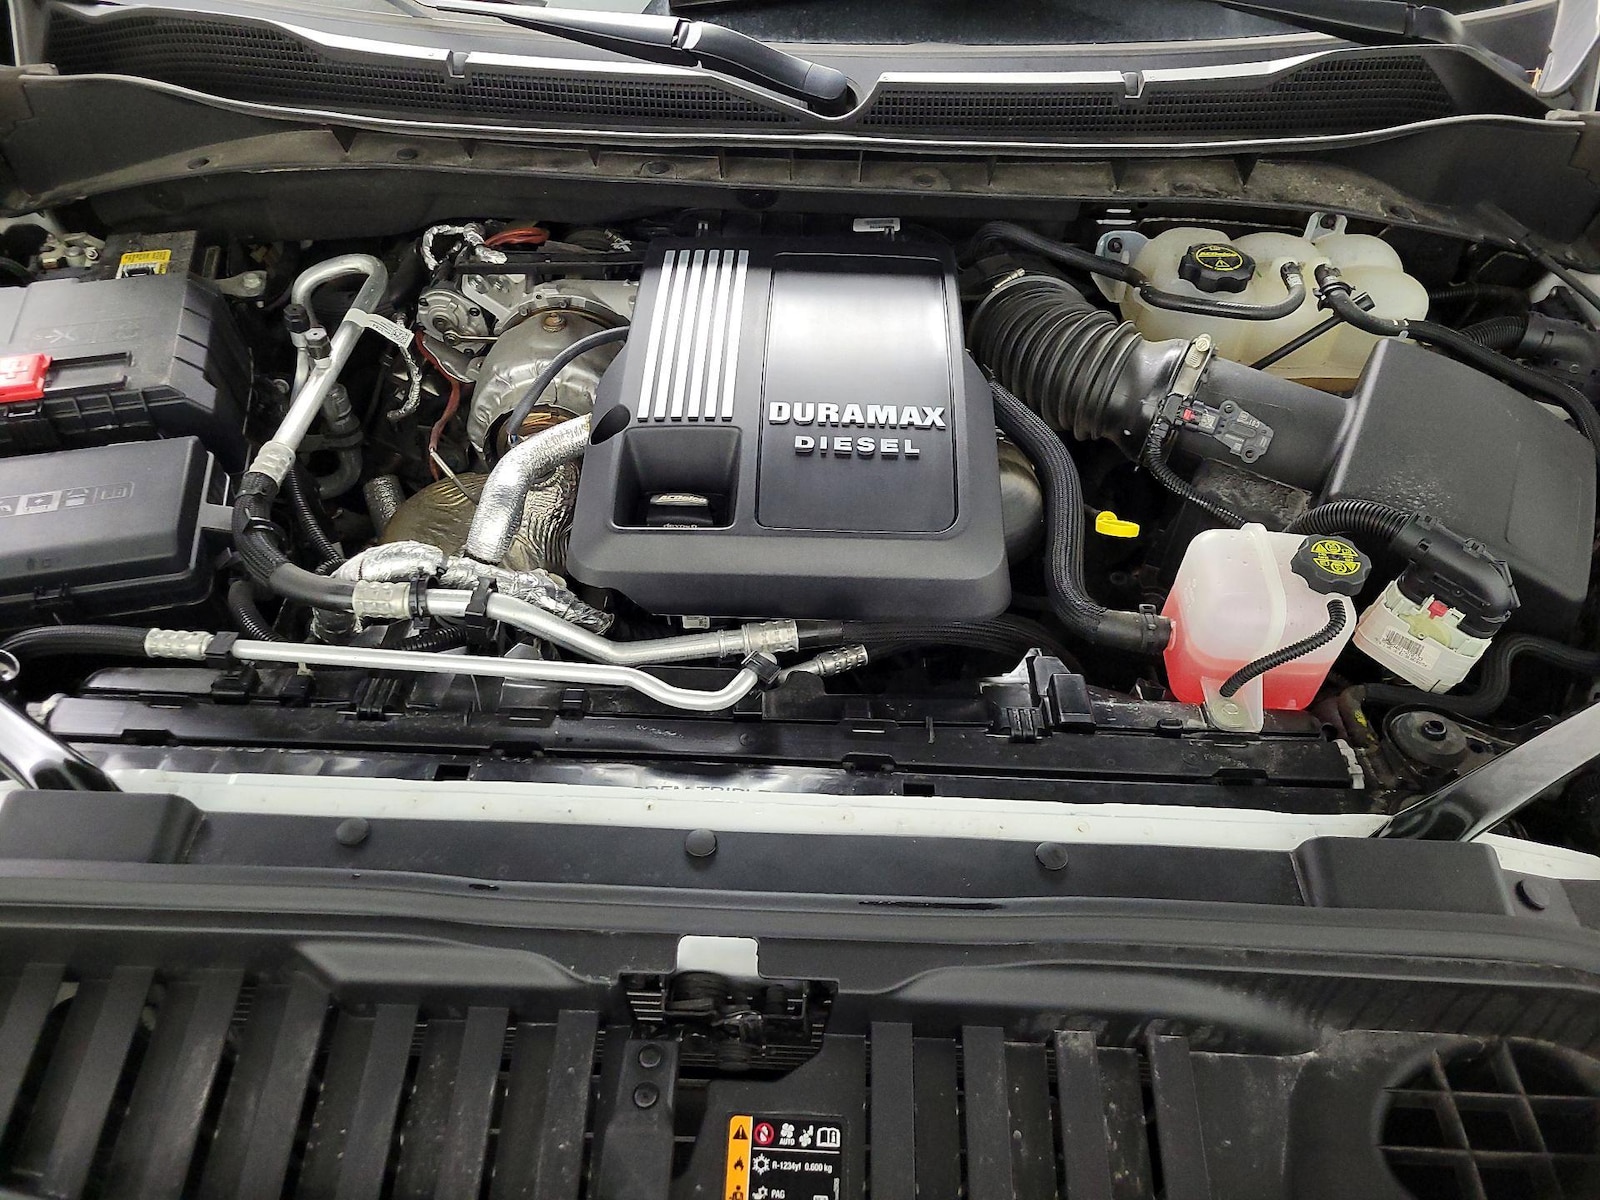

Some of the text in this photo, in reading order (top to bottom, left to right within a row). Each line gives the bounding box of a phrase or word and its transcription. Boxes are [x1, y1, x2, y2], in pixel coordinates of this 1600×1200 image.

[768, 401, 946, 430] DURAMAX
[794, 435, 920, 457] DIESEL
[778, 1137, 796, 1146] AUTO
[771, 1160, 833, 1174] R-1234yf 0.600 kg
[770, 1189, 786, 1199] PAG
